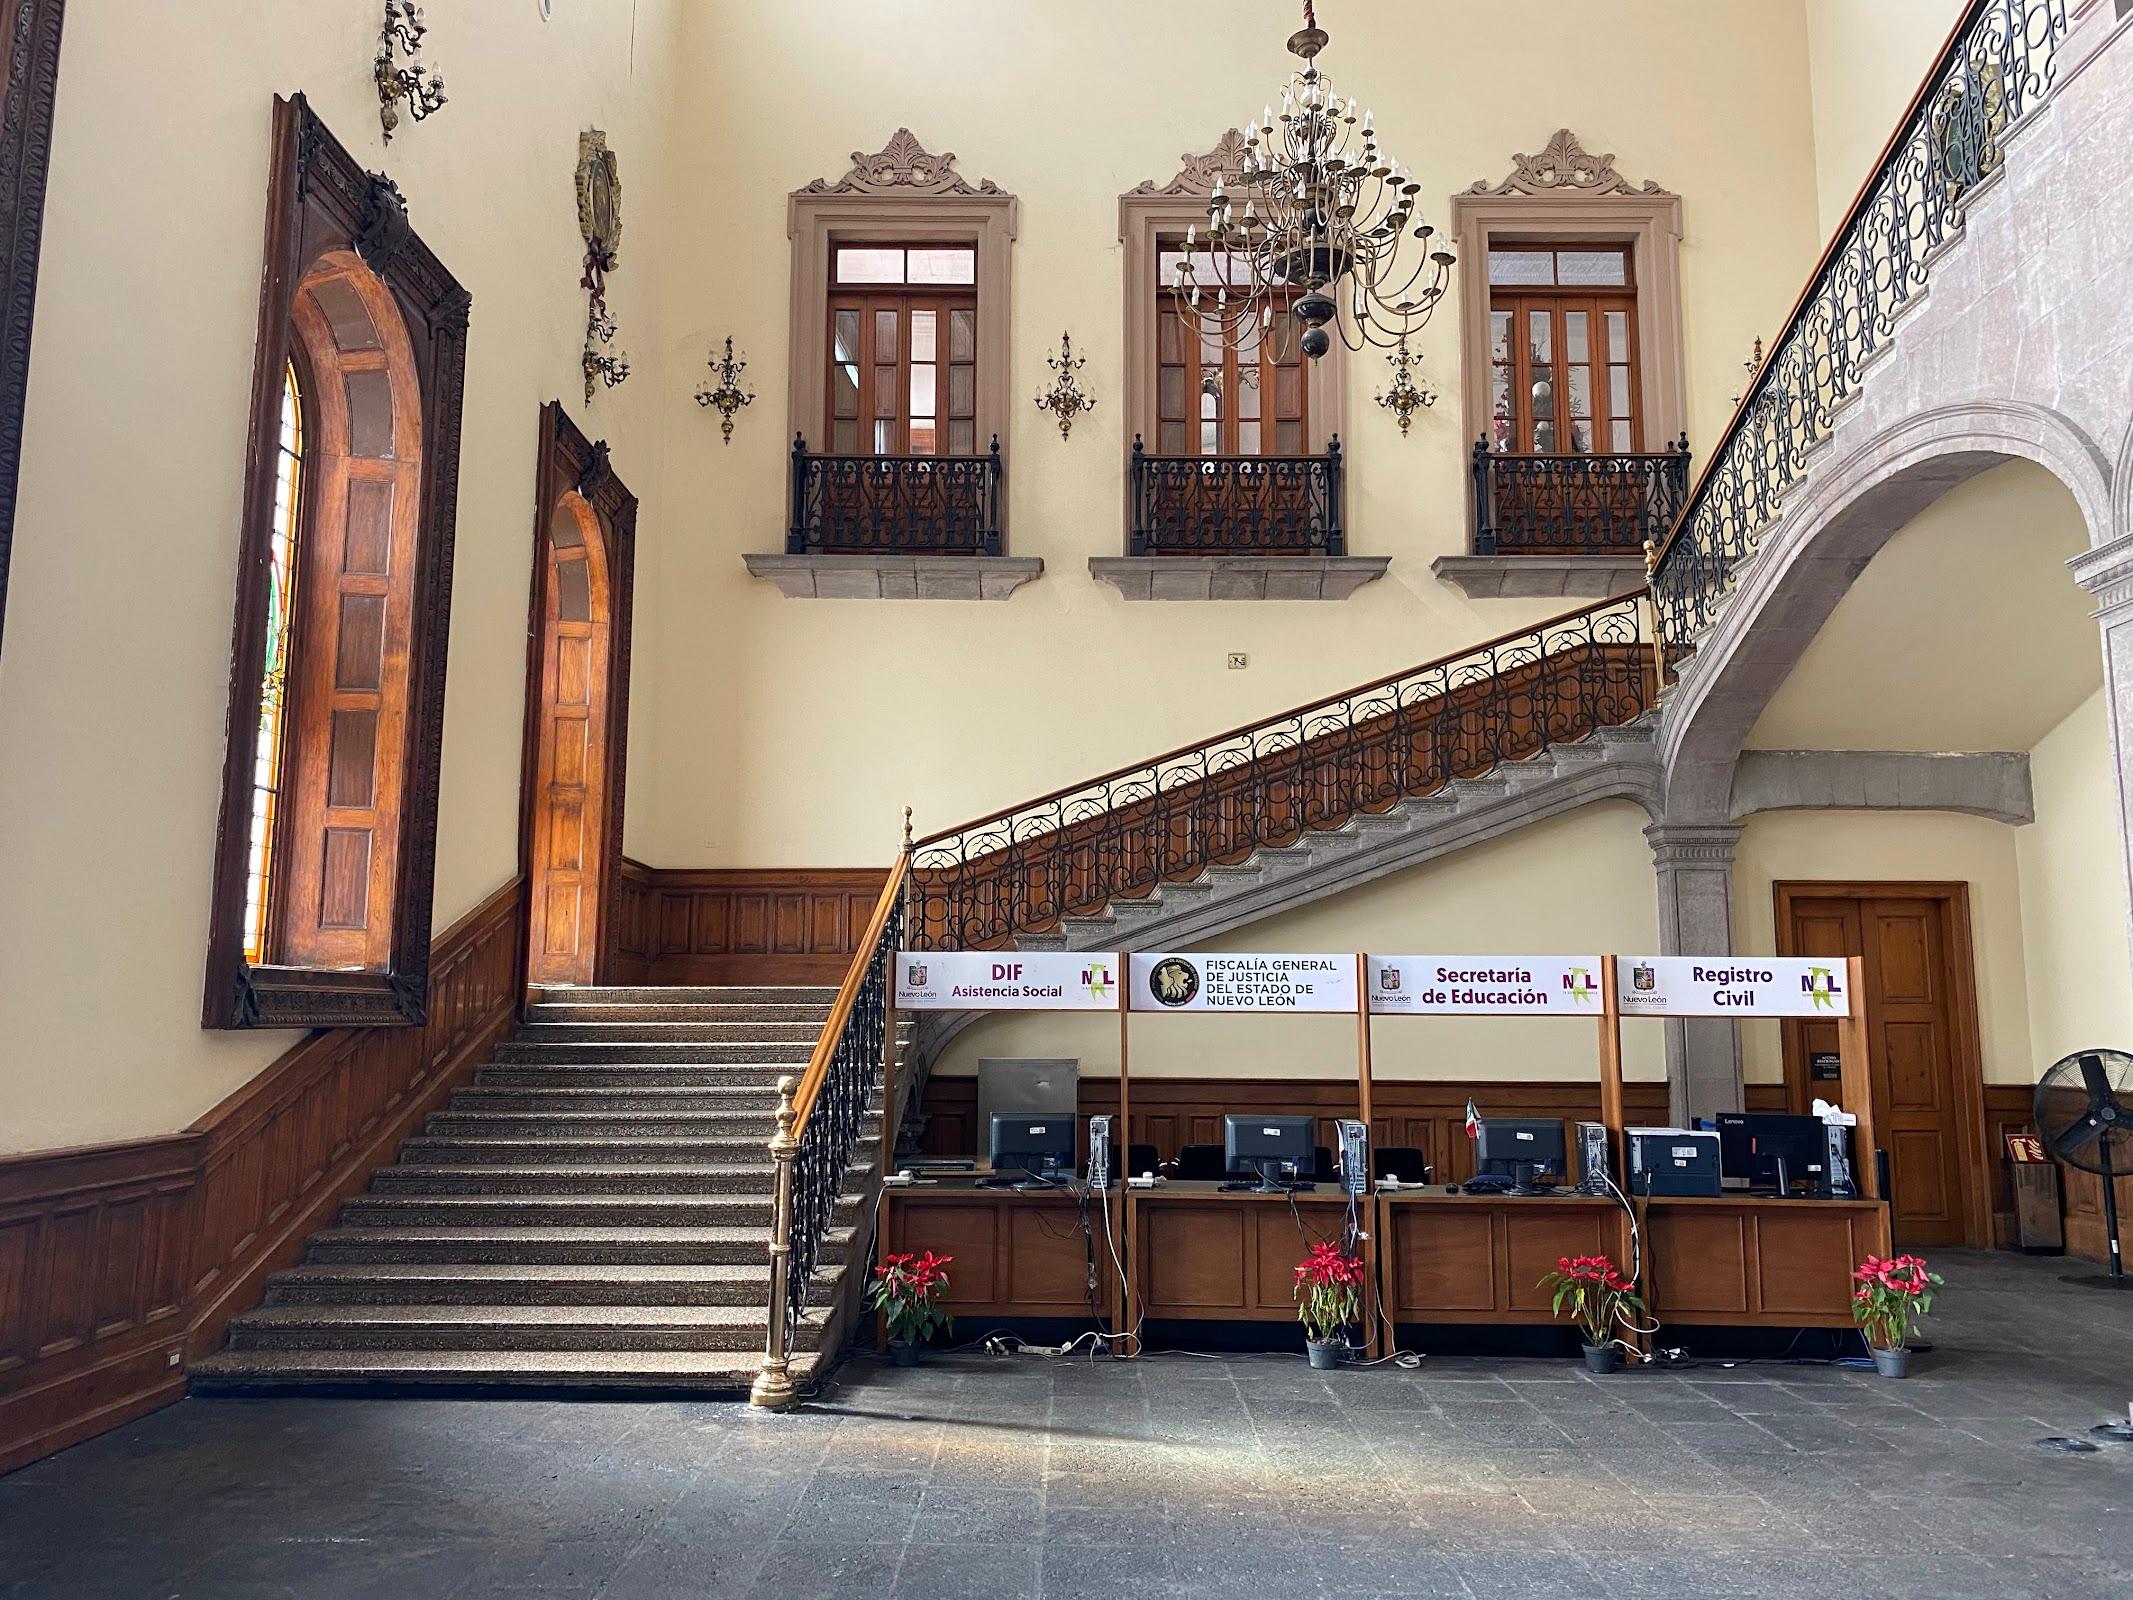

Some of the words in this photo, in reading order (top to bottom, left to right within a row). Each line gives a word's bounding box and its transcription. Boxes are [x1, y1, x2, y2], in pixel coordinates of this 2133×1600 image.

[1206, 958, 1268, 971] FISCALÍA
[1272, 960, 1337, 971] GENERAL
[992, 964, 1023, 980] DIF
[1206, 972, 1225, 982] DE
[1229, 972, 1289, 982] JUSTICIA
[1437, 967, 1532, 982] Secretaría
[1693, 967, 1773, 986] Registro
[952, 985, 1019, 997] Asistencia
[1023, 985, 1062, 997] Social
[1206, 984, 1233, 994] DEL
[1237, 984, 1291, 994] ESTADO
[1295, 984, 1314, 994] DE
[1207, 996, 1254, 1006] NUEVO
[1258, 993, 1296, 1006] LEÓN
[1422, 989, 1447, 1004] de
[1452, 988, 1548, 1004] Educación
[1623, 995, 1647, 1003] Nuevo
[1713, 991, 1754, 1006] Civil
